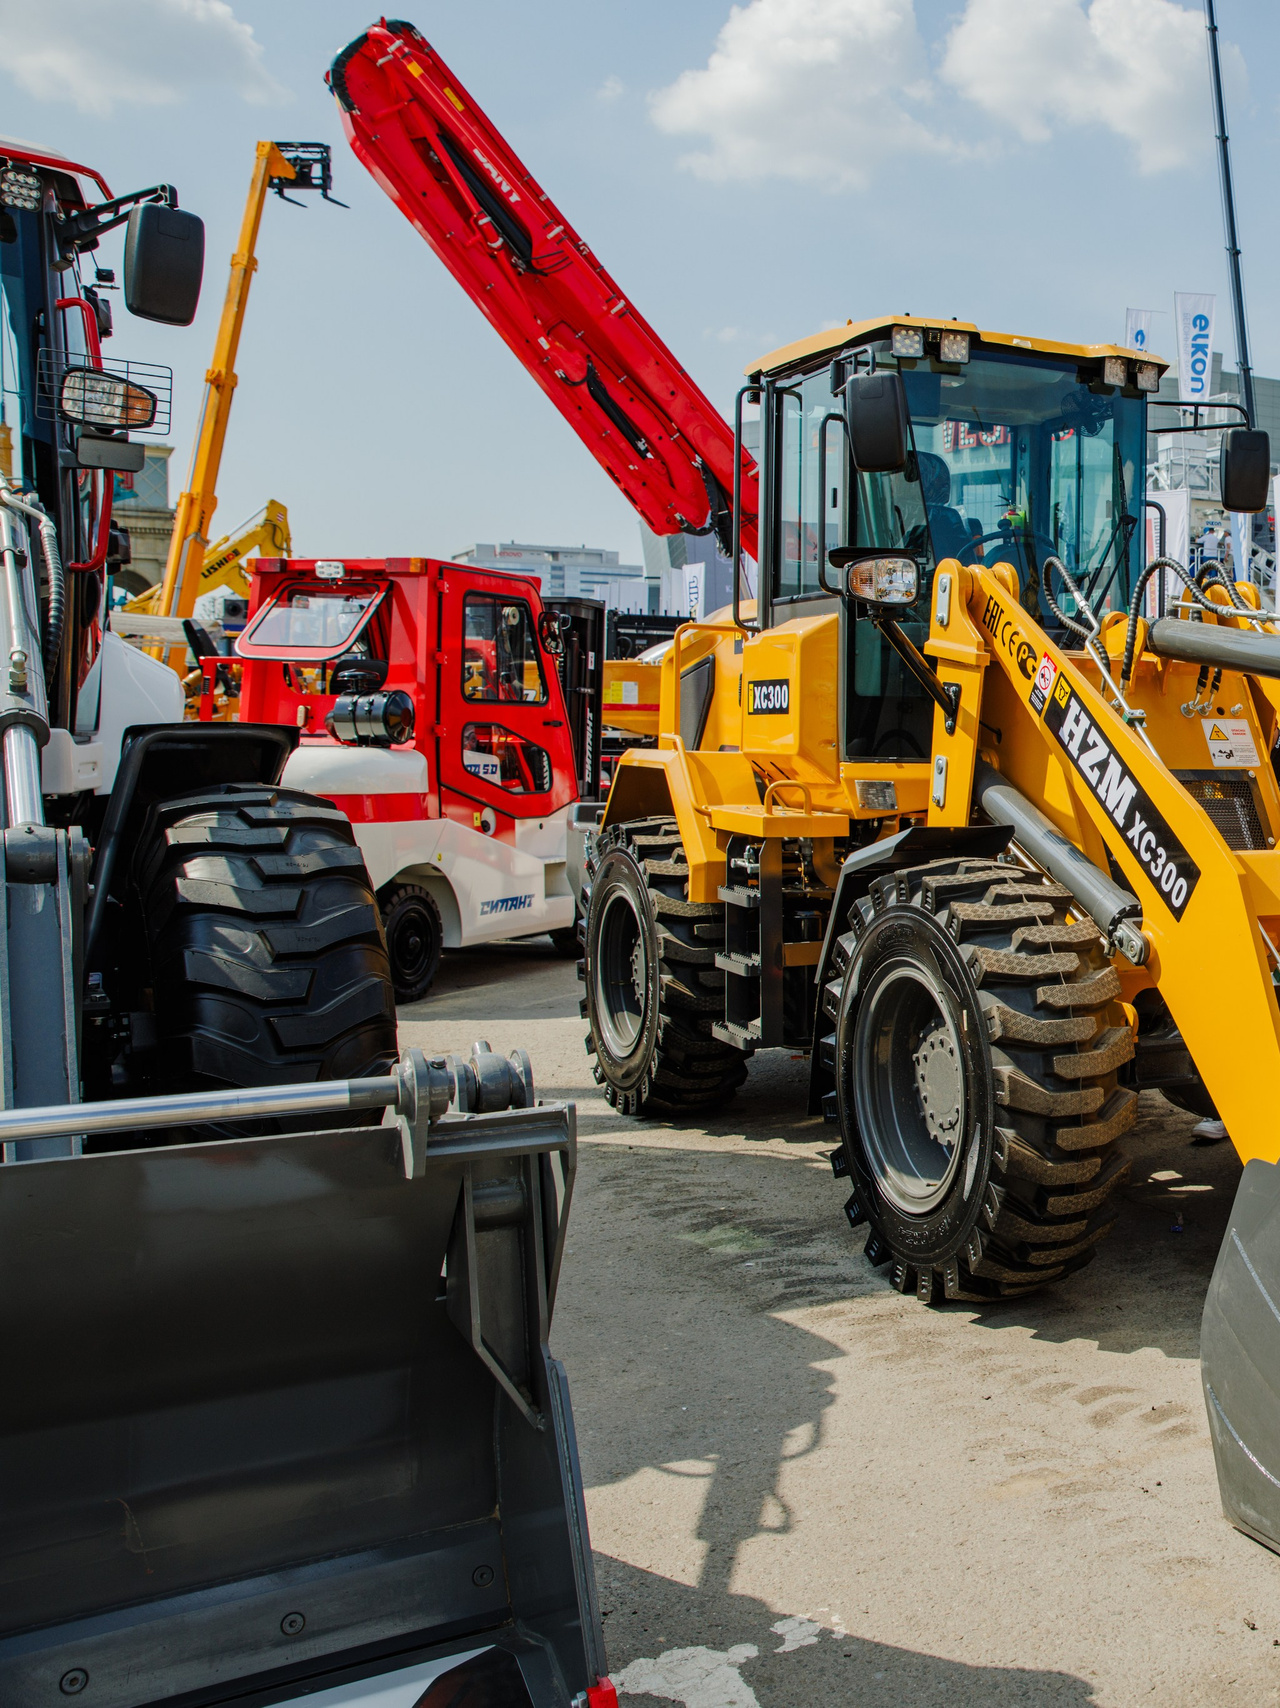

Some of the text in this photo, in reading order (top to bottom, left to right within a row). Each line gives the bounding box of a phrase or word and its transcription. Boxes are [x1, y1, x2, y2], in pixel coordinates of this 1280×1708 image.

[1191, 314, 1209, 393] elkon
[754, 685, 788, 709] XC300
[1059, 697, 1187, 908] HZM XC300
[480, 894, 535, 916] СИЛАНТ
